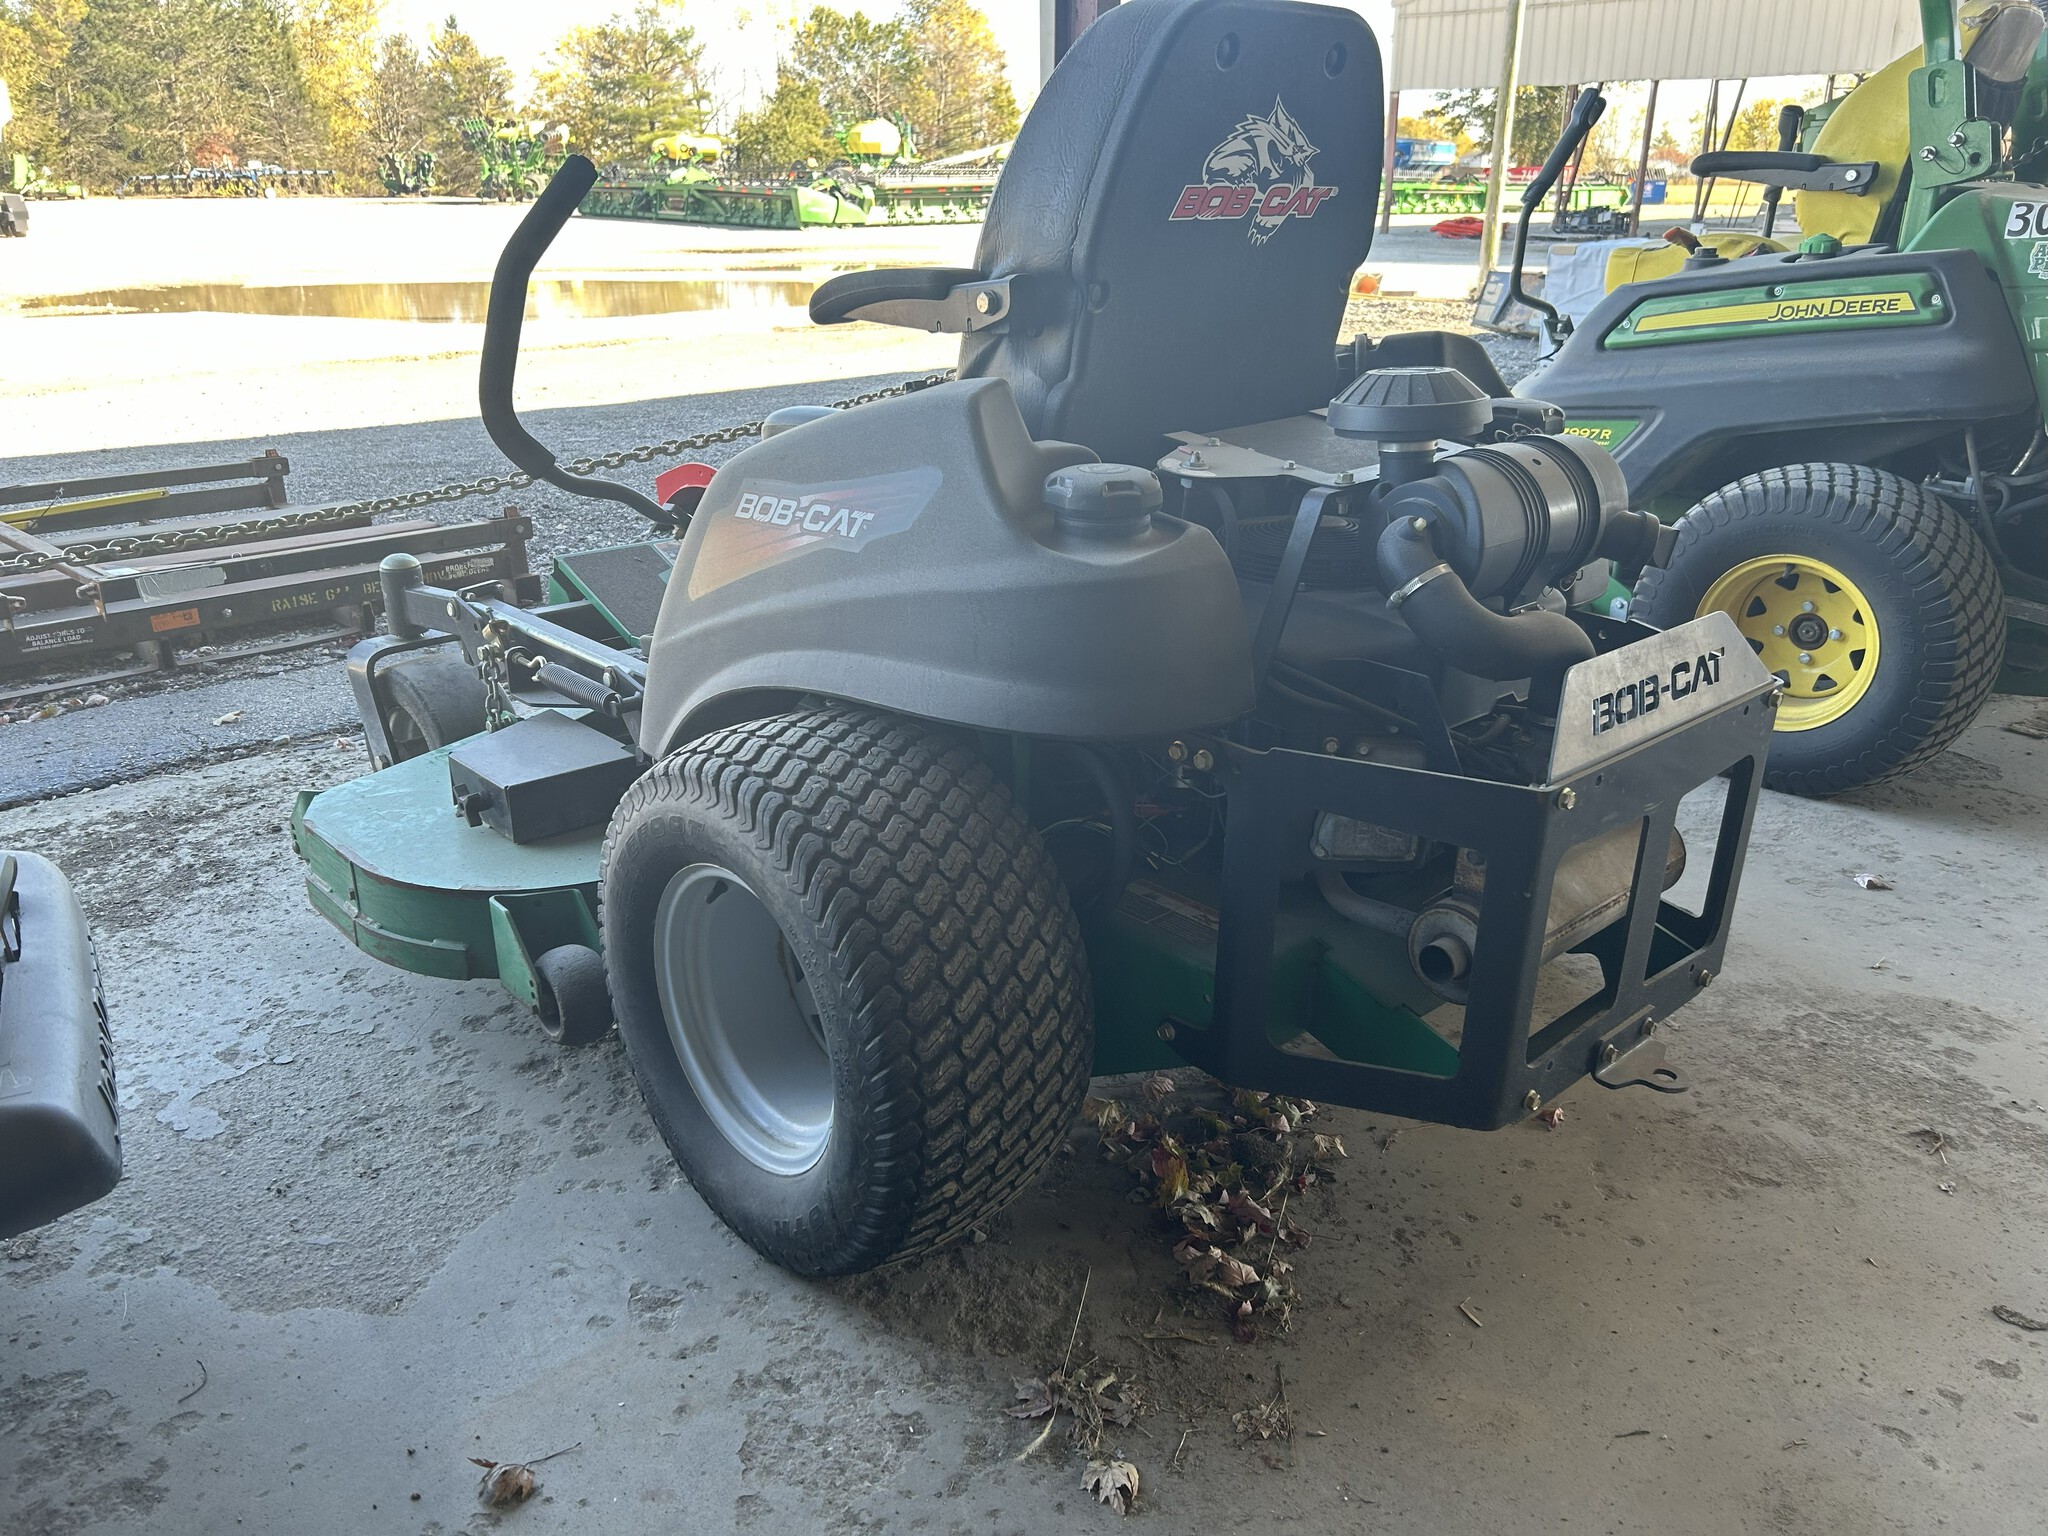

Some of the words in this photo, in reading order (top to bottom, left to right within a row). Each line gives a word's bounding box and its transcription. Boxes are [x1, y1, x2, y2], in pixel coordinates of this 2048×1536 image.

[1169, 184, 1335, 220] BOB-CAT
[1768, 302, 1825, 319] JOHN
[1828, 298, 1901, 315] DEERE
[734, 492, 875, 538] BOB-CAT
[271, 592, 318, 612] RAISE
[26, 632, 50, 642] ADJUST
[53, 629, 75, 638] ORKS
[32, 637, 62, 647] BALANCE
[63, 634, 81, 643] LOAD
[1592, 646, 1725, 736] BOB-CAT
